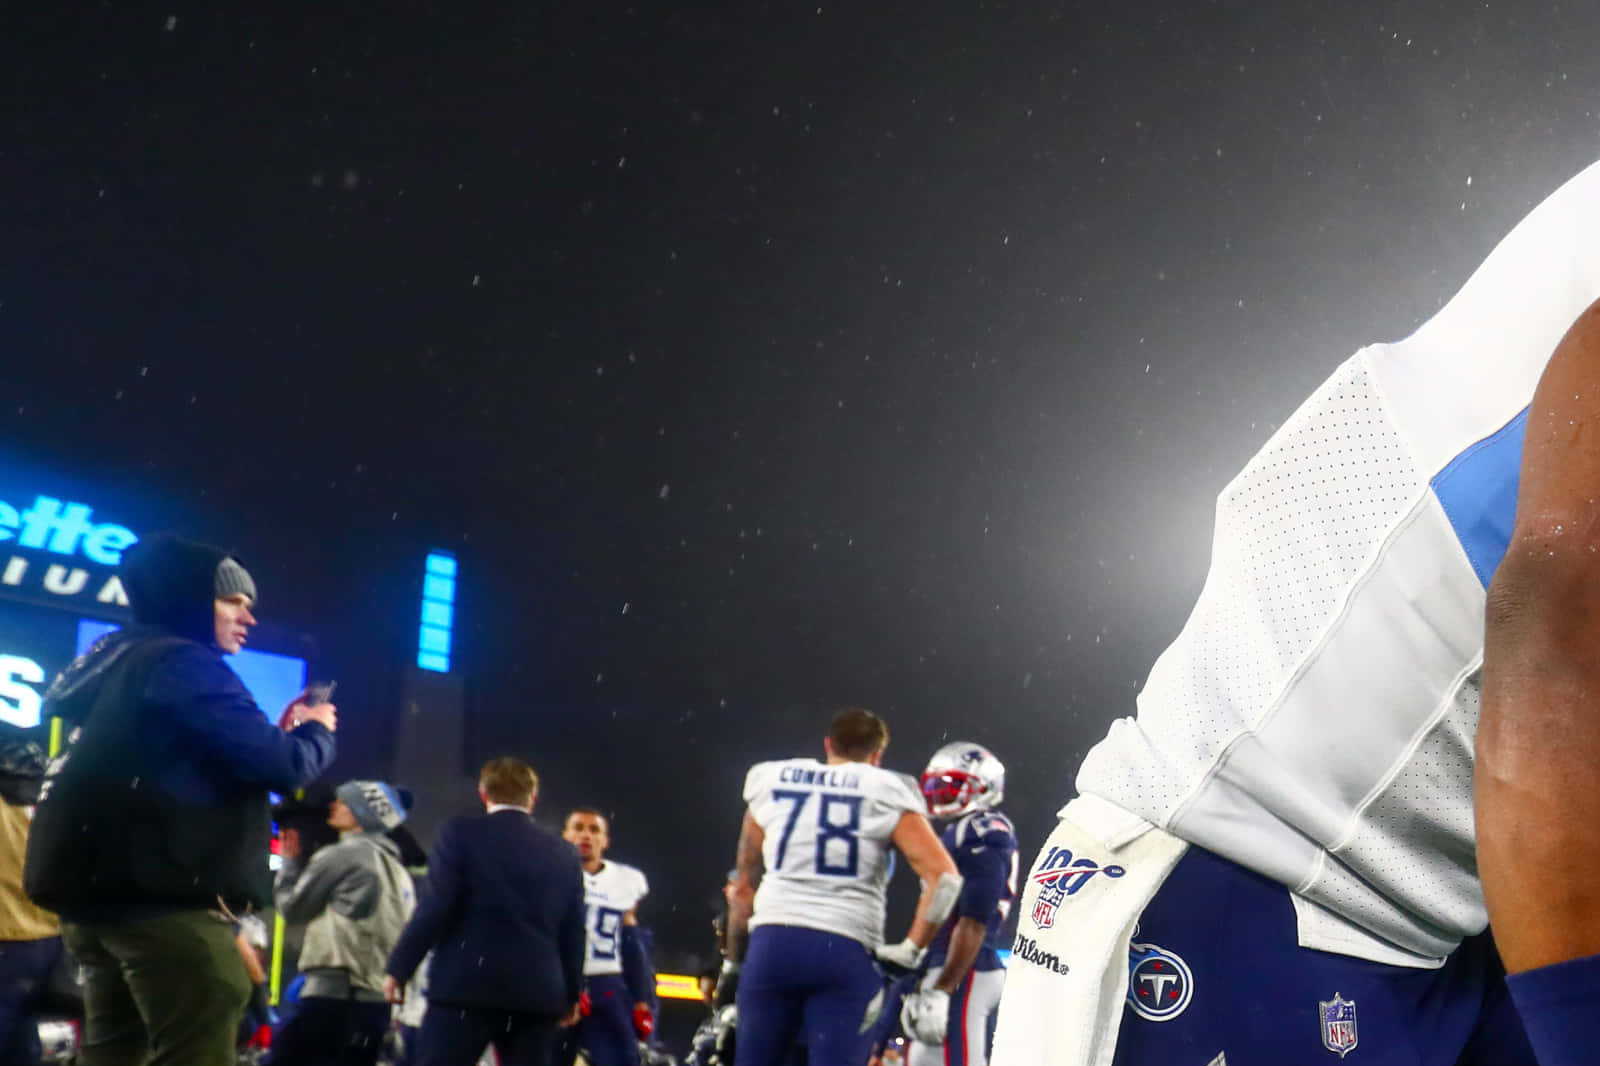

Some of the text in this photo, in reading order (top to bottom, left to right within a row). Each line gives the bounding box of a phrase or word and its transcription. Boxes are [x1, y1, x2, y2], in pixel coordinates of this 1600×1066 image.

[772, 790, 864, 877] 78
[1033, 901, 1053, 925] NFL
[1330, 1021, 1354, 1046] NFL
